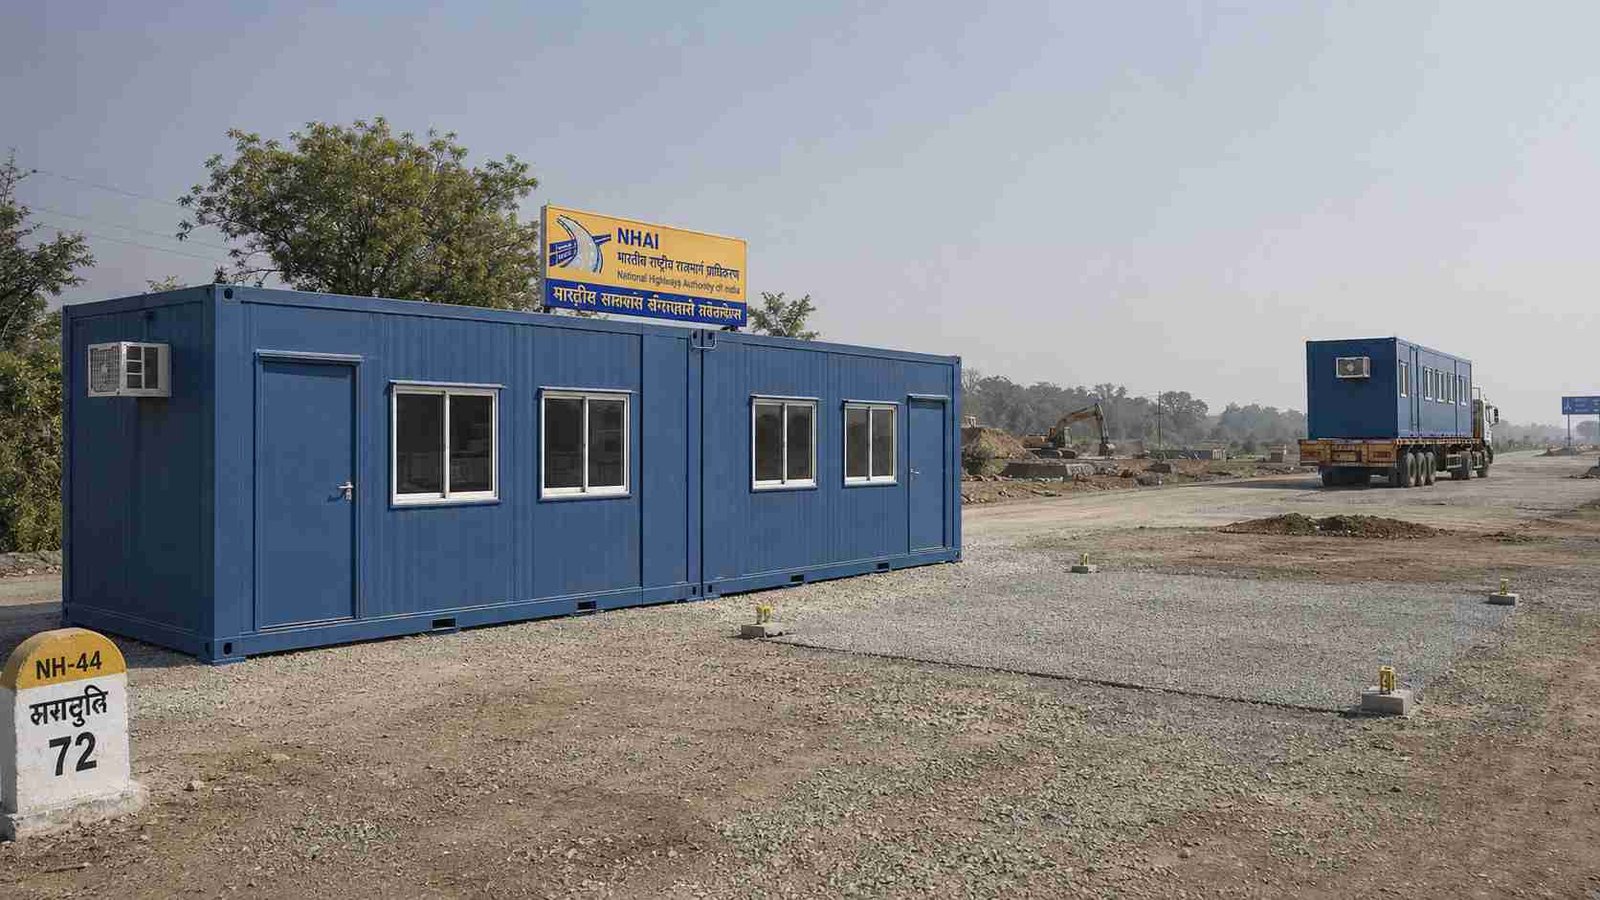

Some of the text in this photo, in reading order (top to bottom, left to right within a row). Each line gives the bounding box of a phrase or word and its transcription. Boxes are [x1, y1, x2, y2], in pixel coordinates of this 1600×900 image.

[617, 228, 659, 249] NHAI
[617, 270, 648, 282] National
[35, 650, 102, 680] NH-44
[49, 732, 97, 776] 72
